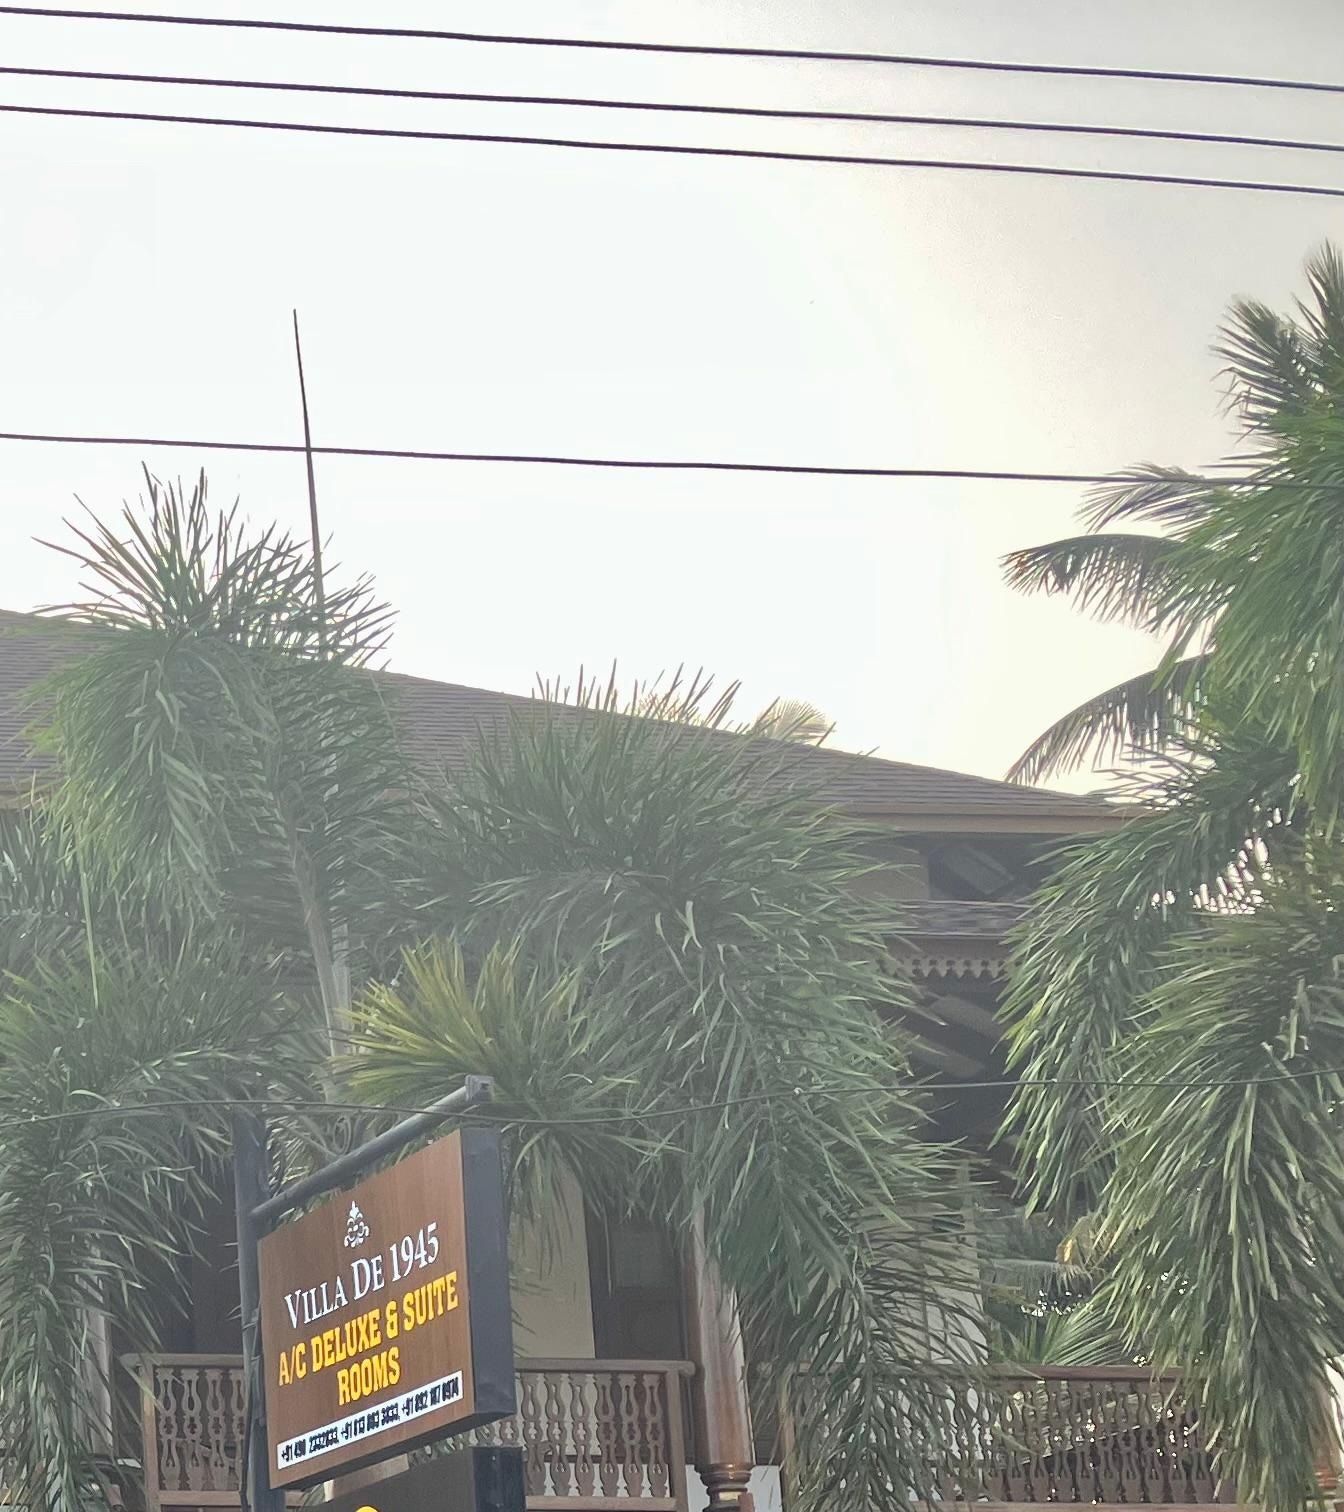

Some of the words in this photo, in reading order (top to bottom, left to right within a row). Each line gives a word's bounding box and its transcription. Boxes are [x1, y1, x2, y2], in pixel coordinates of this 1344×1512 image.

[389, 1222, 439, 1282] 1945
[278, 1342, 307, 1386] A/C
[310, 1308, 382, 1373] DELUXE
[385, 1300, 399, 1339] &
[403, 1271, 459, 1331] SUITE
[336, 1346, 401, 1406] ROOMS
